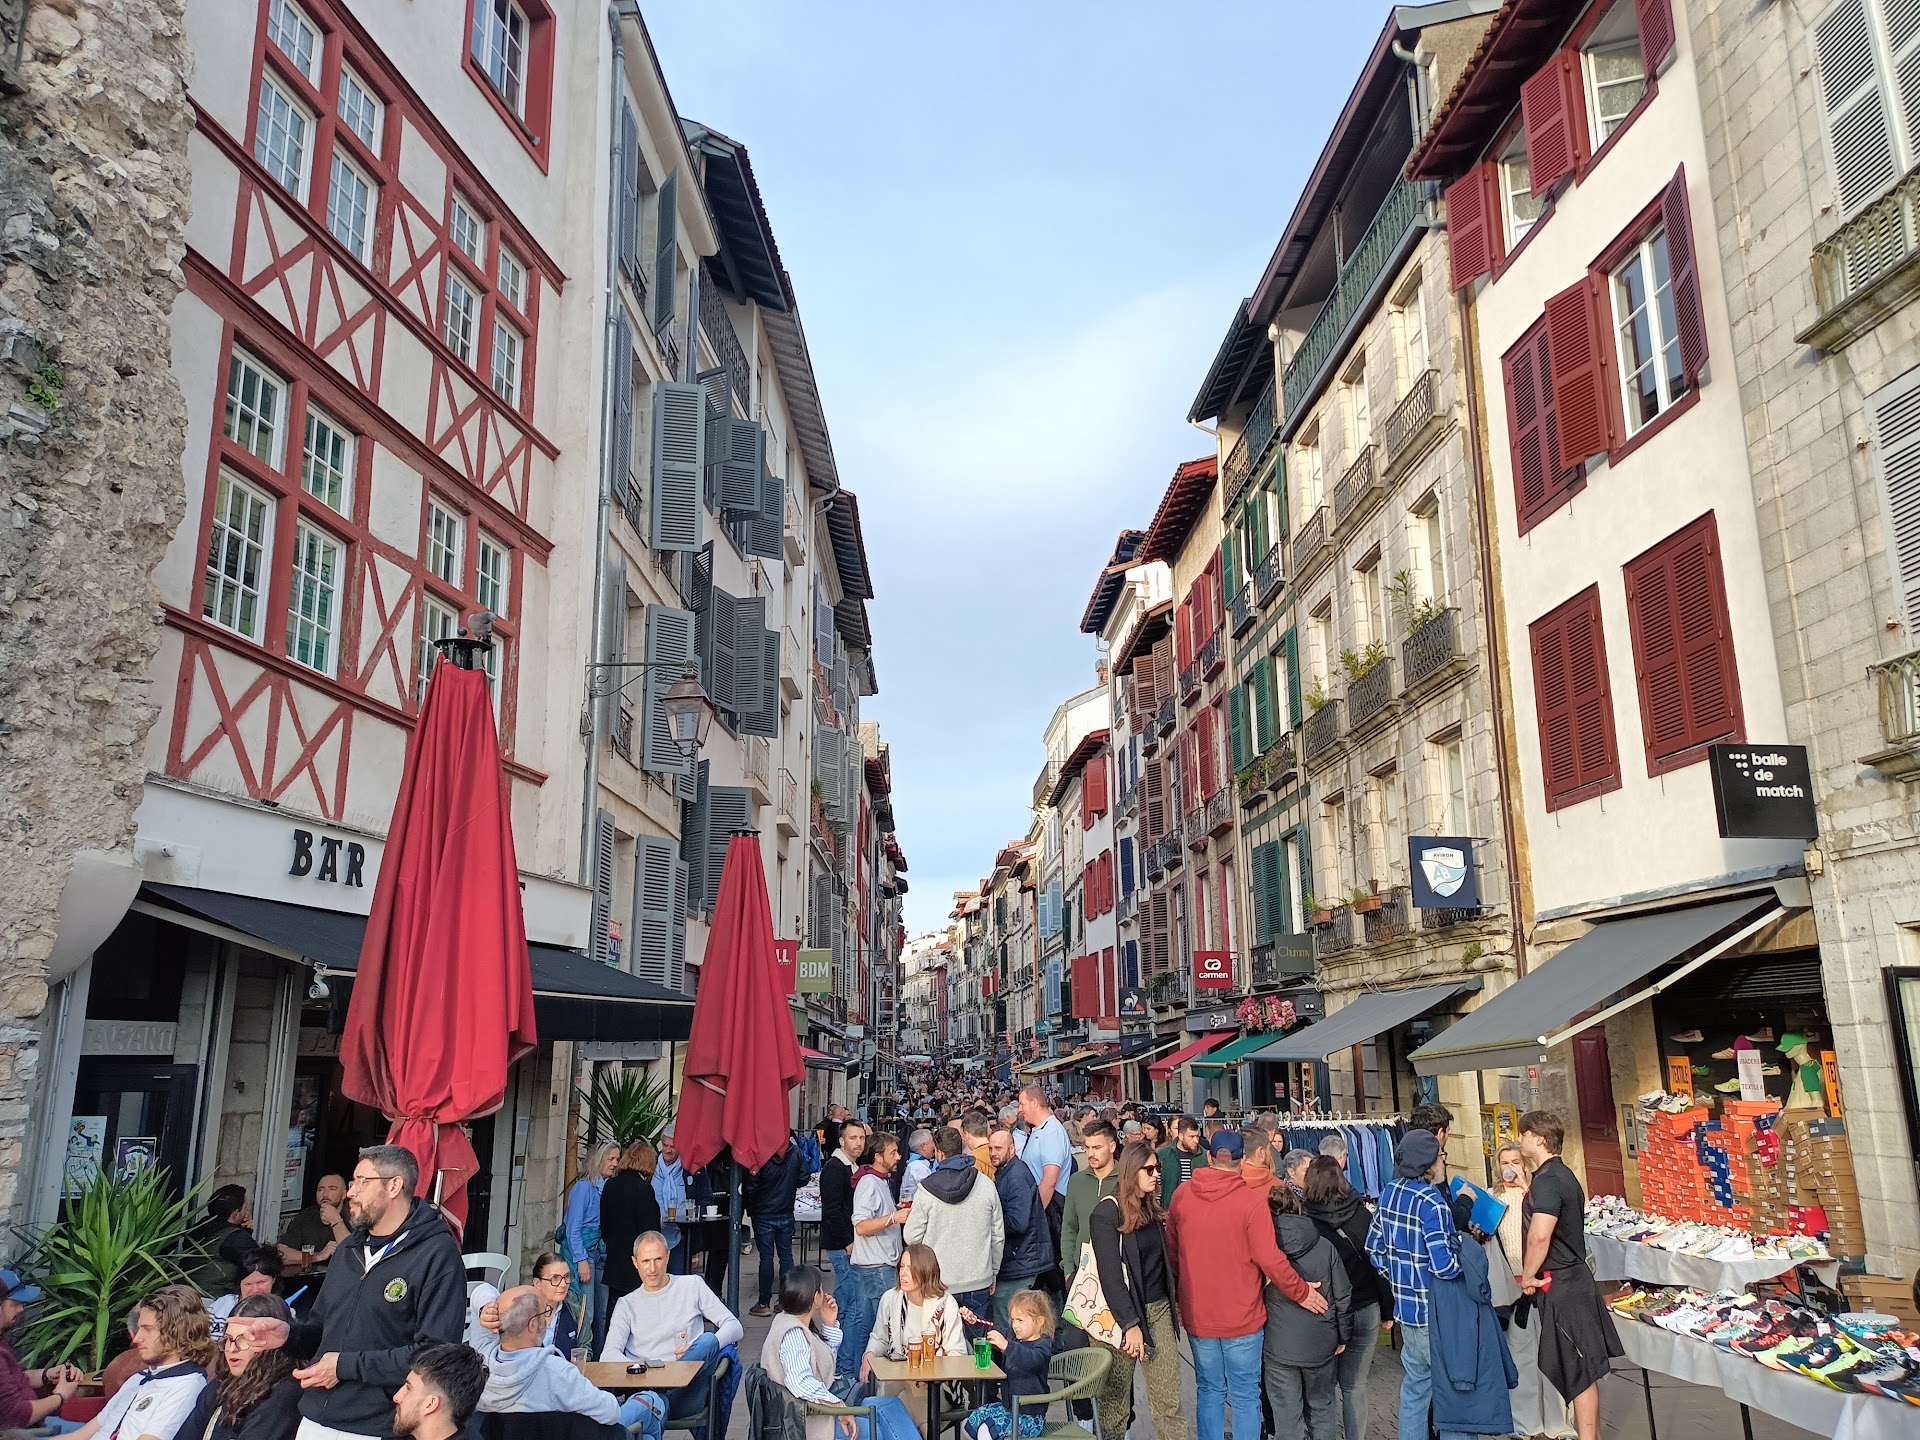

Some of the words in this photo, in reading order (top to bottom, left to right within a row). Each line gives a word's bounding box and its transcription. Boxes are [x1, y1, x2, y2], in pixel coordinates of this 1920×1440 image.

[1751, 753, 1787, 766] balle
[1754, 769, 1773, 781] de
[1756, 785, 1803, 797] match
[289, 829, 365, 888] BAR
[1433, 866, 1451, 880] AB
[1278, 946, 1311, 961] Chummy
[800, 962, 829, 978] BDM
[1671, 1065, 1689, 1084] TEXTILE
